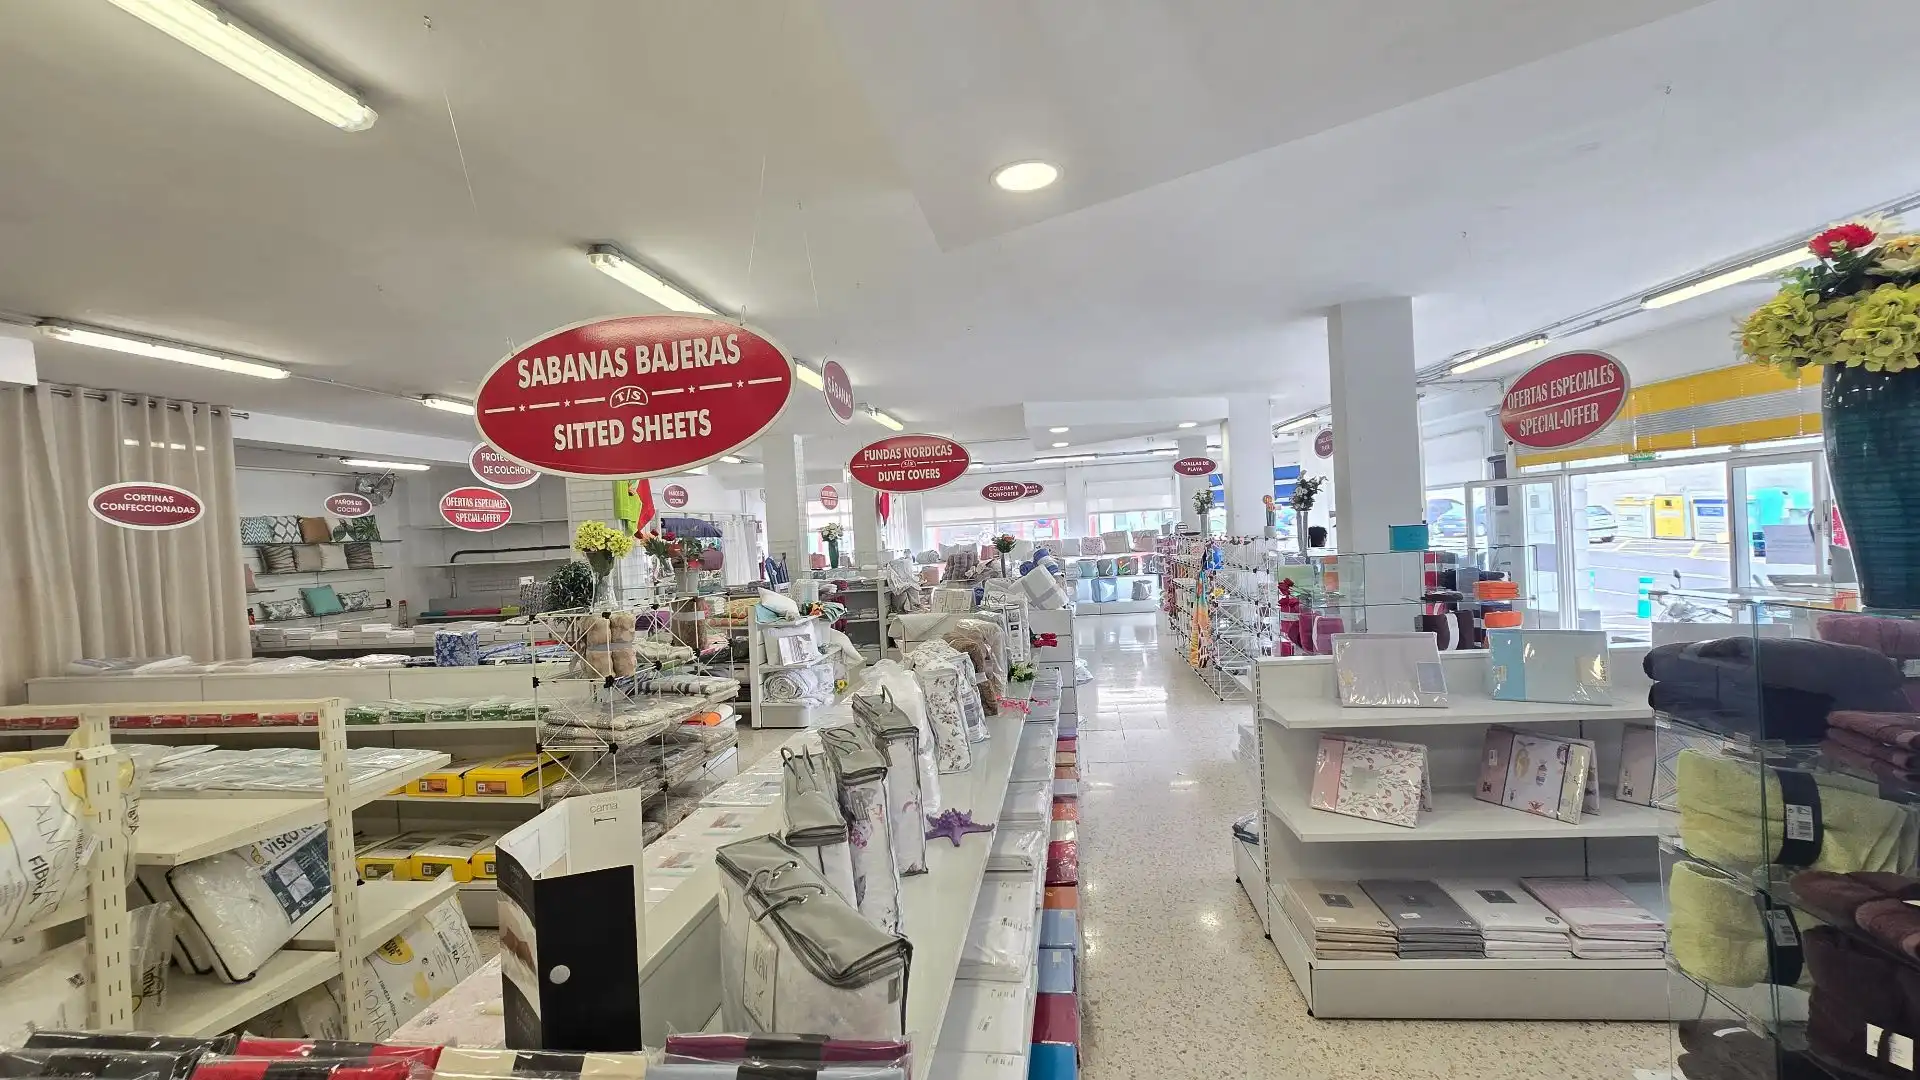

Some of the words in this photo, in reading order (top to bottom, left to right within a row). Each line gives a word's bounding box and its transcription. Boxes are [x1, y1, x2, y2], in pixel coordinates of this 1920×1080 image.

[518, 347, 629, 388] SABANAS
[636, 333, 741, 375] BAJERAS
[1507, 383, 1548, 410] OFERTAS
[1550, 362, 1615, 399] ESPECIALES
[615, 388, 641, 404] T/S
[1519, 402, 1599, 437] SPECIAL-OFFER
[553, 418, 625, 451] SITTED
[631, 408, 712, 443] SHEETS
[864, 448, 902, 461] FUNDAS
[904, 444, 953, 459] NORDICAS
[483, 465, 493, 474] DE
[878, 470, 906, 482] DUVET
[907, 468, 941, 480] COVERS
[123, 493, 175, 503] CORTINAS
[334, 498, 355, 506] PAÑOS
[445, 496, 474, 507] OFERTAS
[474, 498, 507, 509] ESPECIALES
[100, 502, 196, 514] CONFECCIONADAS
[455, 512, 501, 523] SPECIAL-OFFER
[589, 801, 618, 814] cama
[263, 830, 300, 855] VISCO
[28, 855, 50, 905] FIBRA
